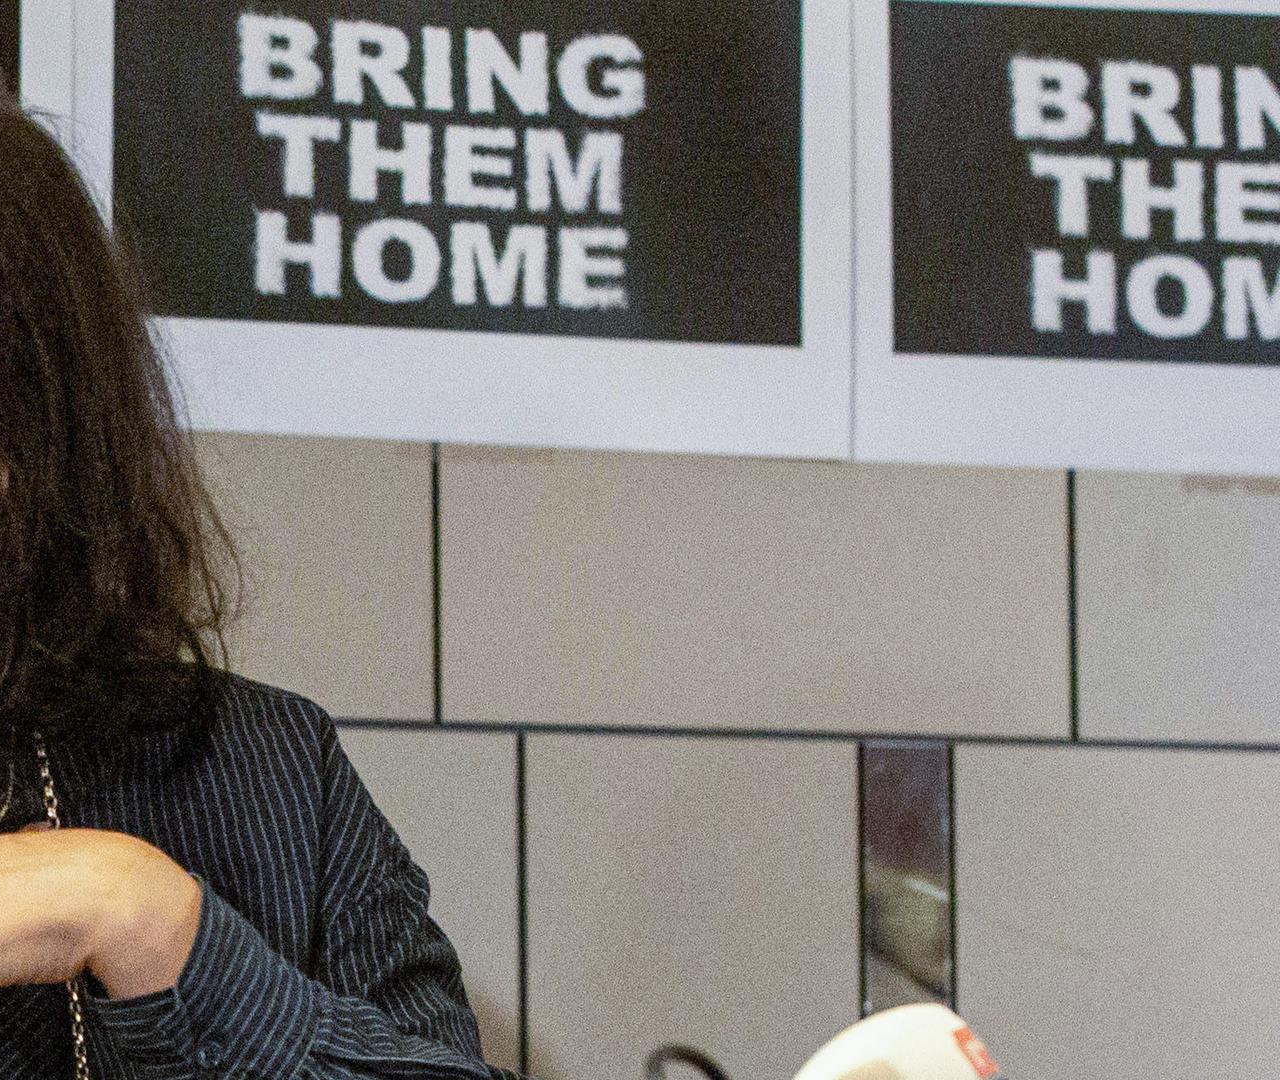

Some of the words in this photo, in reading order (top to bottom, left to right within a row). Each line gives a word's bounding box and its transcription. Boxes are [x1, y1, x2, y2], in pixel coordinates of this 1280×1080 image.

[238, 11, 646, 120] BRING
[255, 111, 623, 214] THEM
[254, 209, 629, 310] HOME
